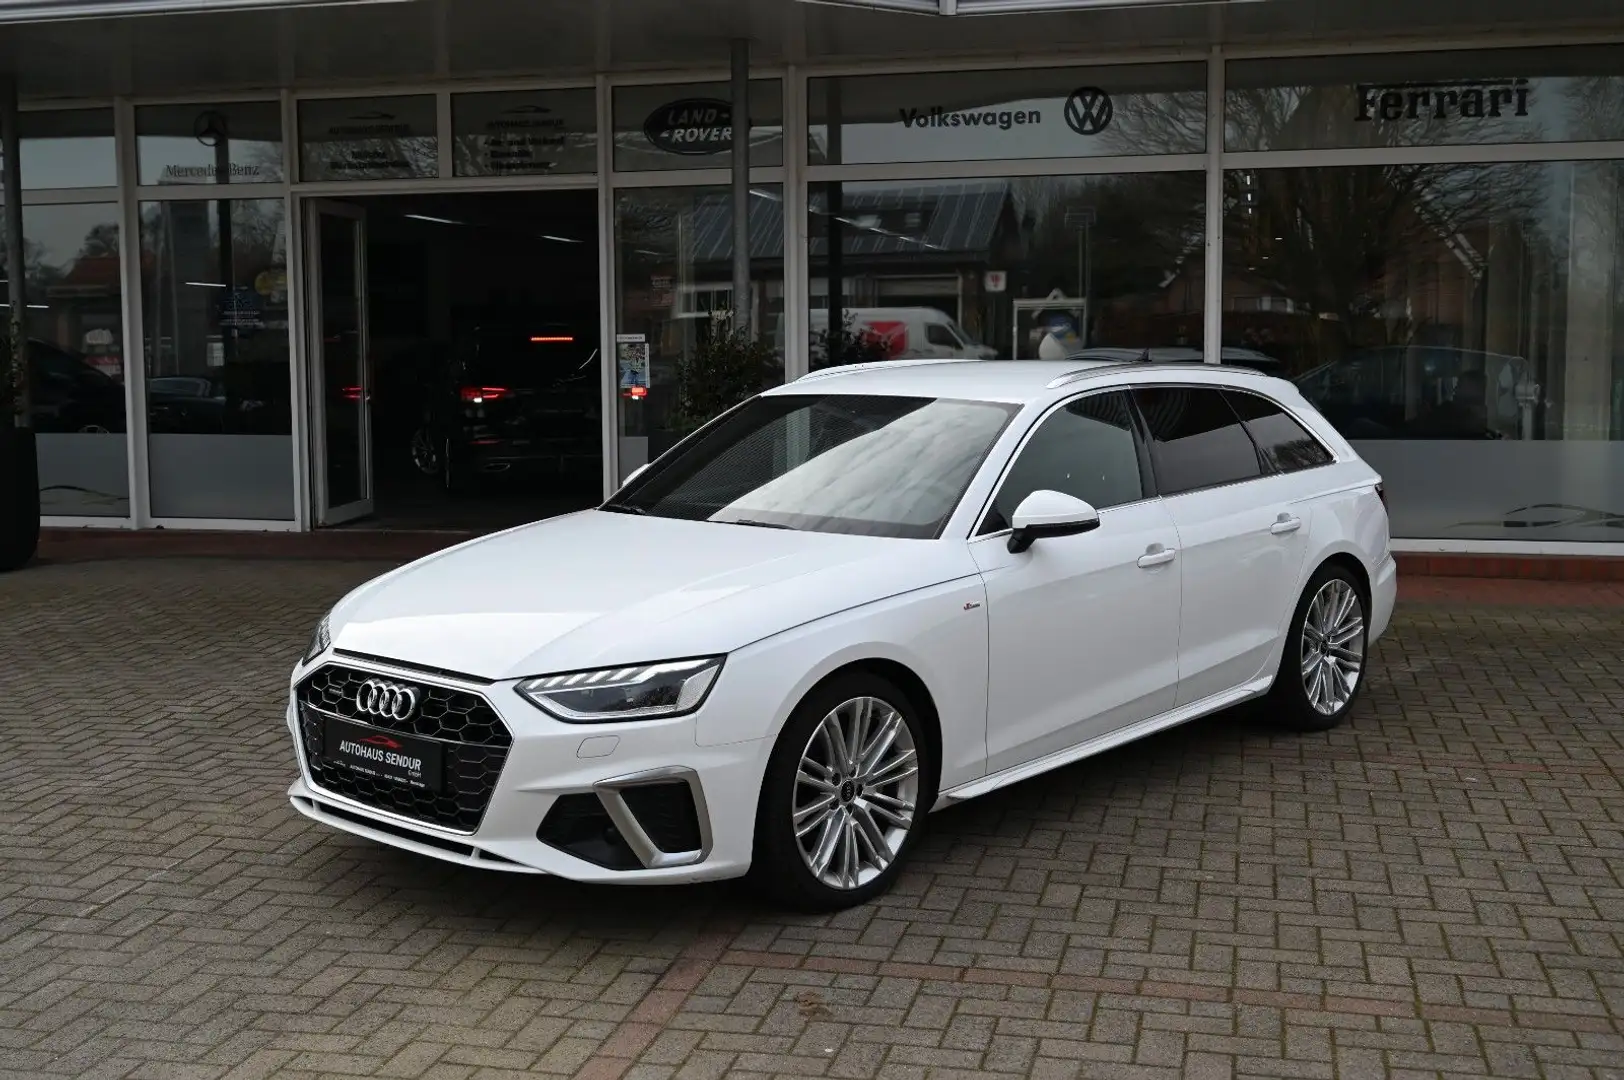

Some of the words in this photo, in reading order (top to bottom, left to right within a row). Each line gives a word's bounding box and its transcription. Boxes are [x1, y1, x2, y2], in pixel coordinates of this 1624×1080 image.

[1354, 78, 1529, 121] Ferrari
[667, 107, 718, 125] LAND
[899, 105, 1042, 131] Volkswagen
[671, 126, 732, 144] ROVER
[166, 163, 260, 178] MercedeBenz
[339, 740, 383, 762] AUTOHAUS
[385, 752, 422, 771] SENDUR
